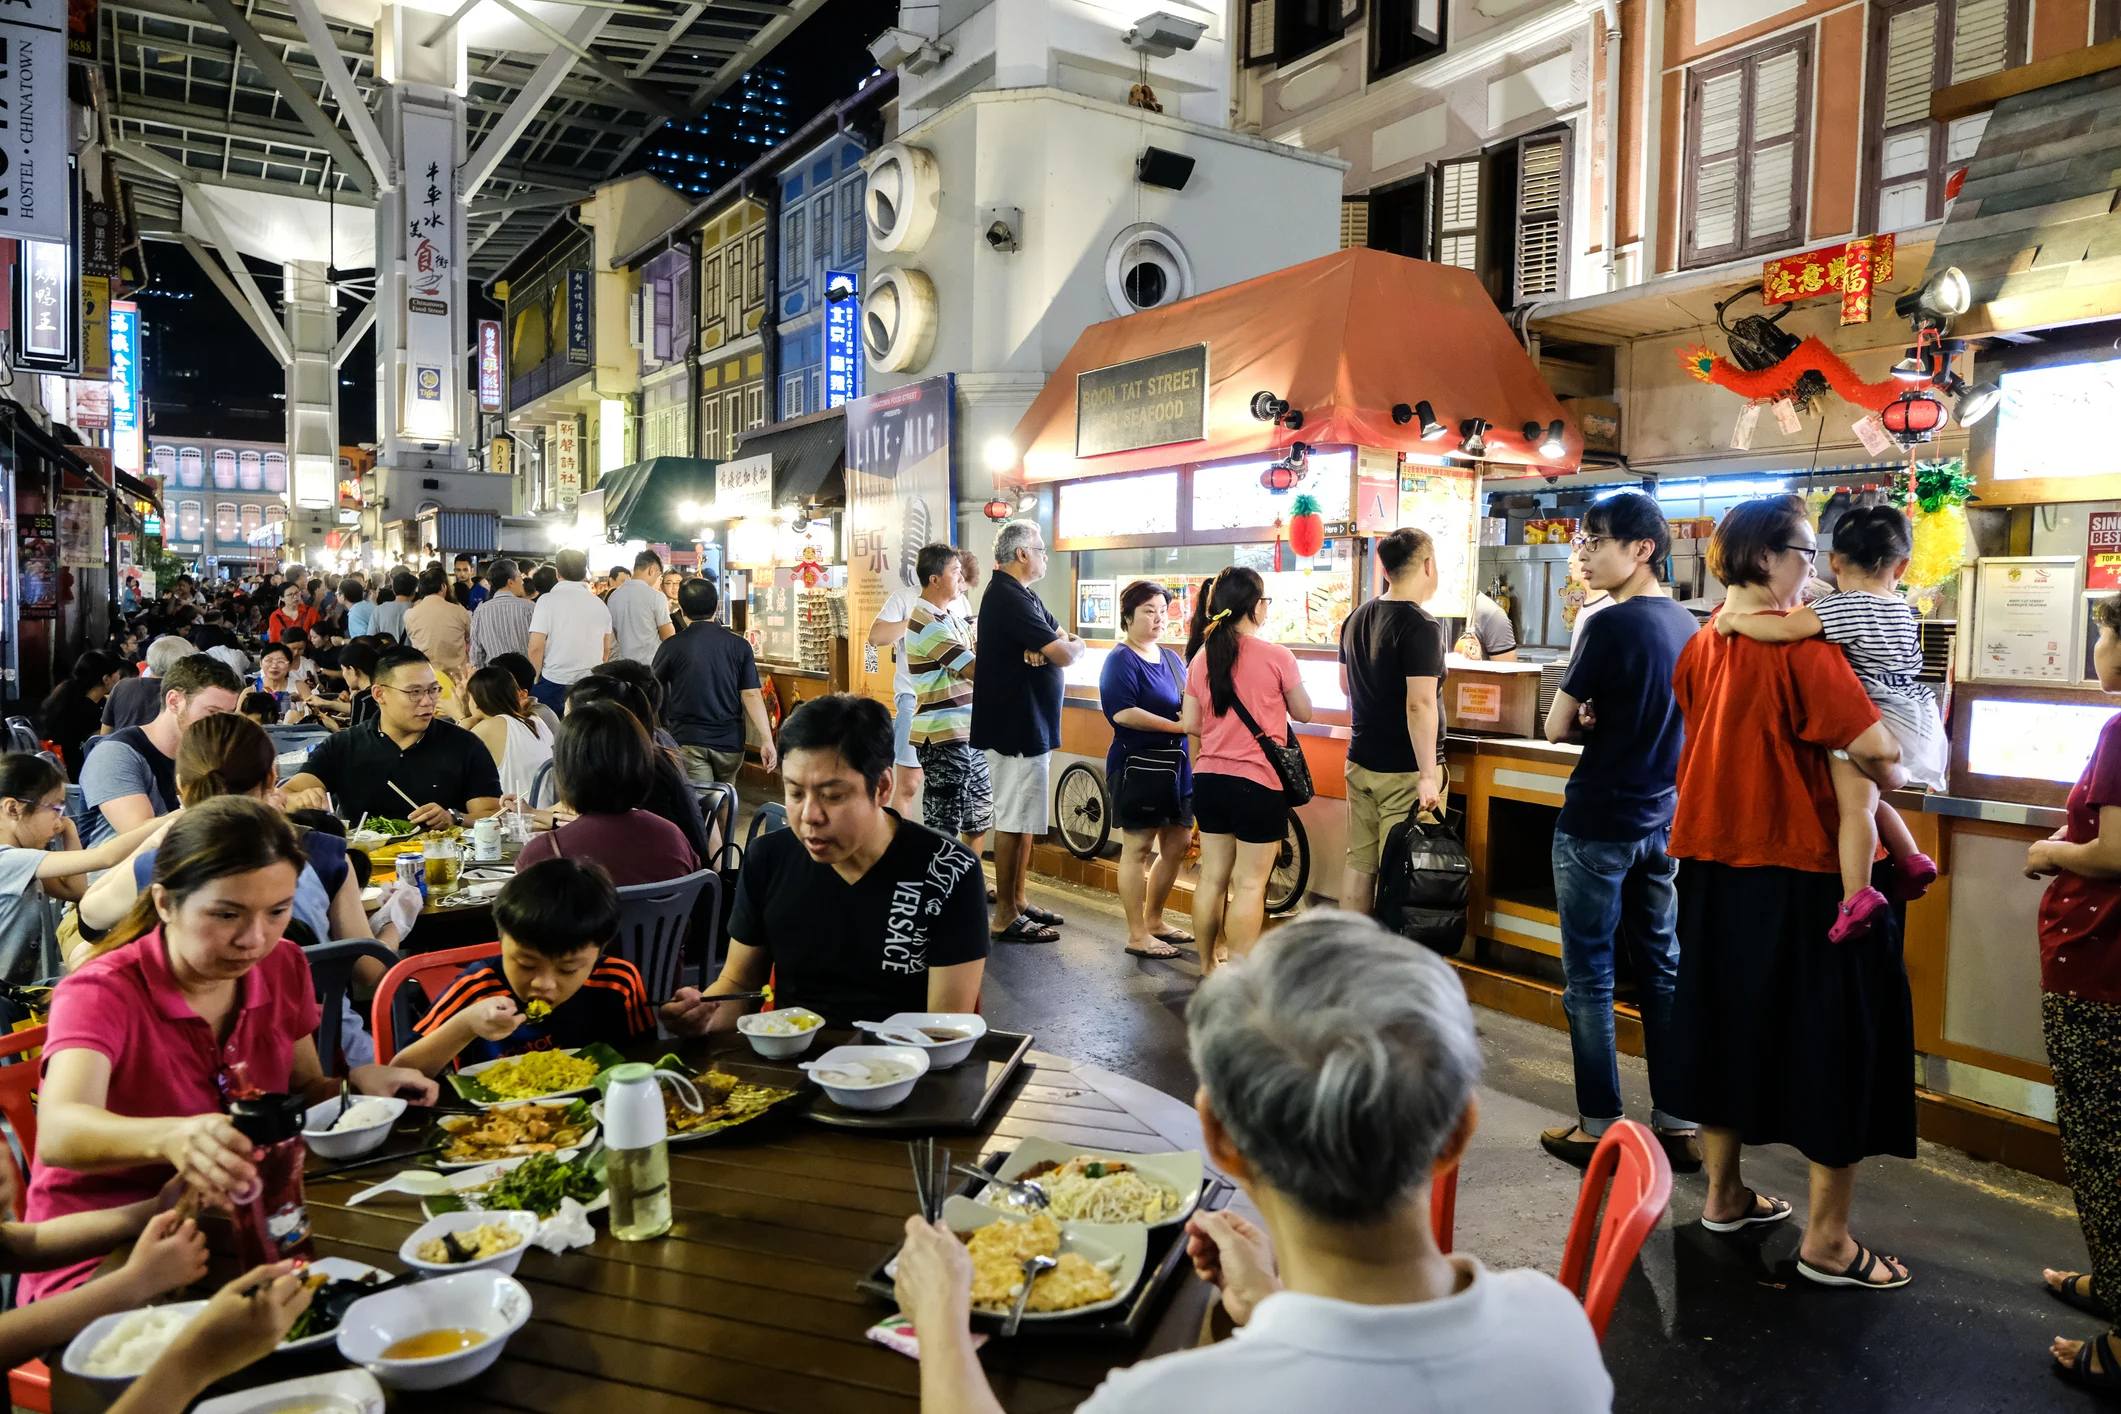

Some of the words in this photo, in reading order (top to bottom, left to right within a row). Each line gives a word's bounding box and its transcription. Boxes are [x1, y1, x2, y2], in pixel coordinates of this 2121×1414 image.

[20, 40, 33, 144] CHINATOWN
[20, 160, 34, 219] HOSTEL
[1843, 263, 1868, 293] 福
[1083, 386, 1115, 408] BOON
[1121, 380, 1142, 402] TAT
[1148, 368, 1198, 396] STREET
[1123, 400, 1184, 426] SEAFOOD
[857, 424, 891, 465] LIVE
[904, 413, 935, 456] MIC
[882, 881, 924, 975] VERSACE
